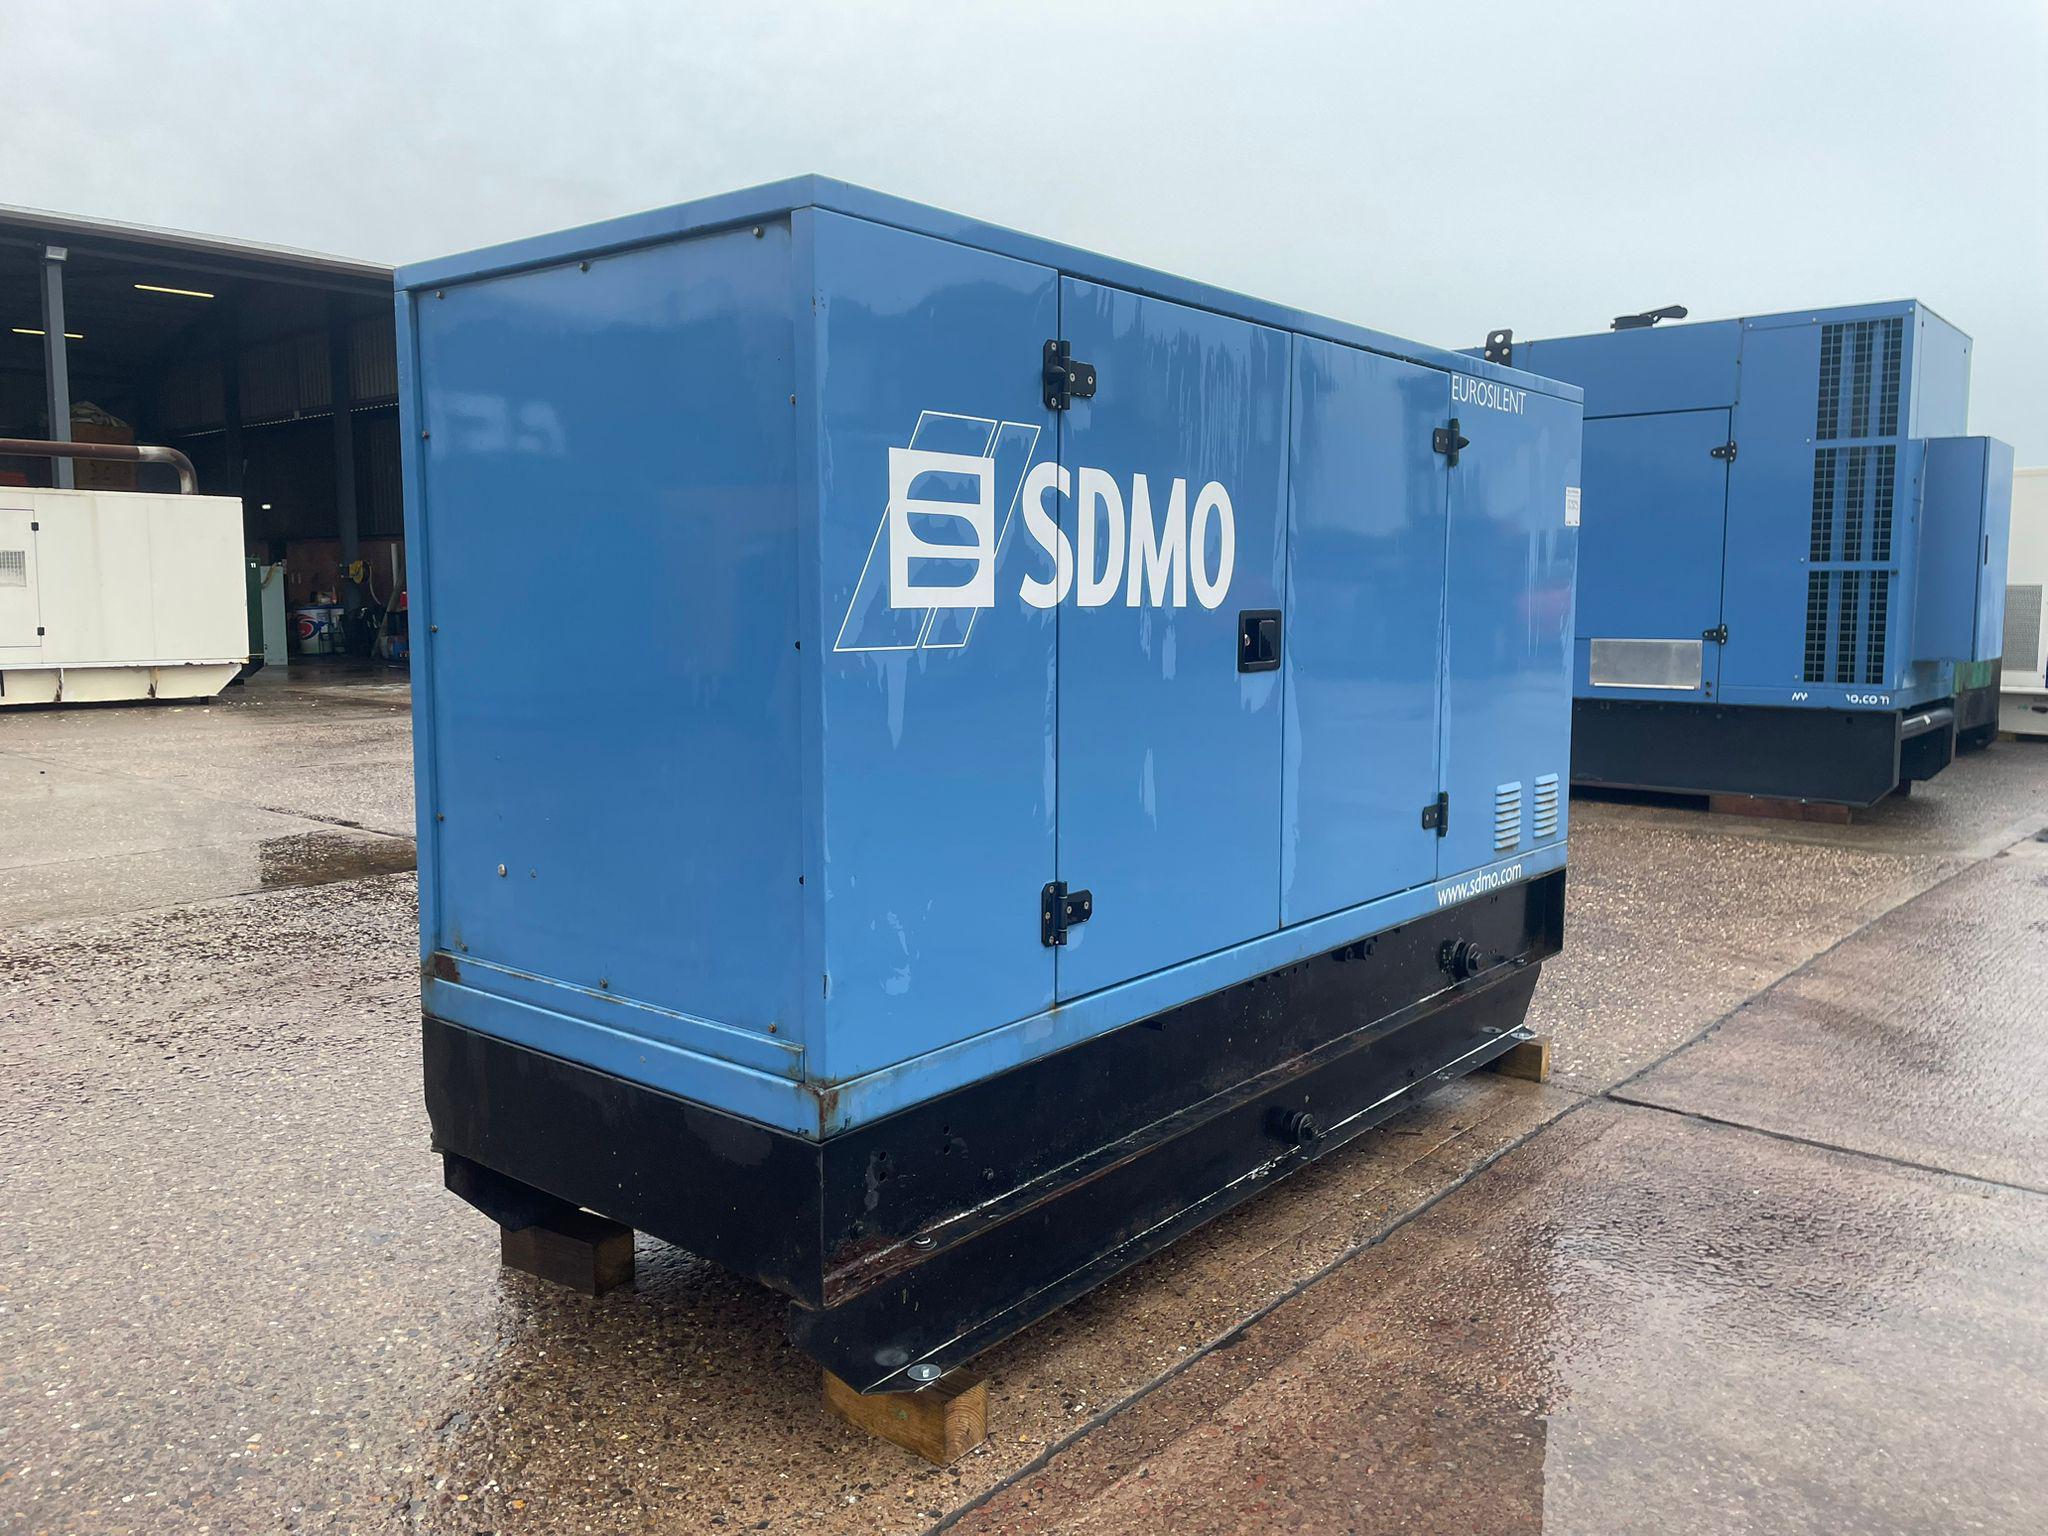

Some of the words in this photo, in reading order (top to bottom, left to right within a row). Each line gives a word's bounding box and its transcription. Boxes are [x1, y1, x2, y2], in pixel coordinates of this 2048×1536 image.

[1452, 374, 1527, 415] EUROSILENT
[1018, 461, 1236, 609] SDMO
[1437, 863, 1522, 907] www.sdmo.com
